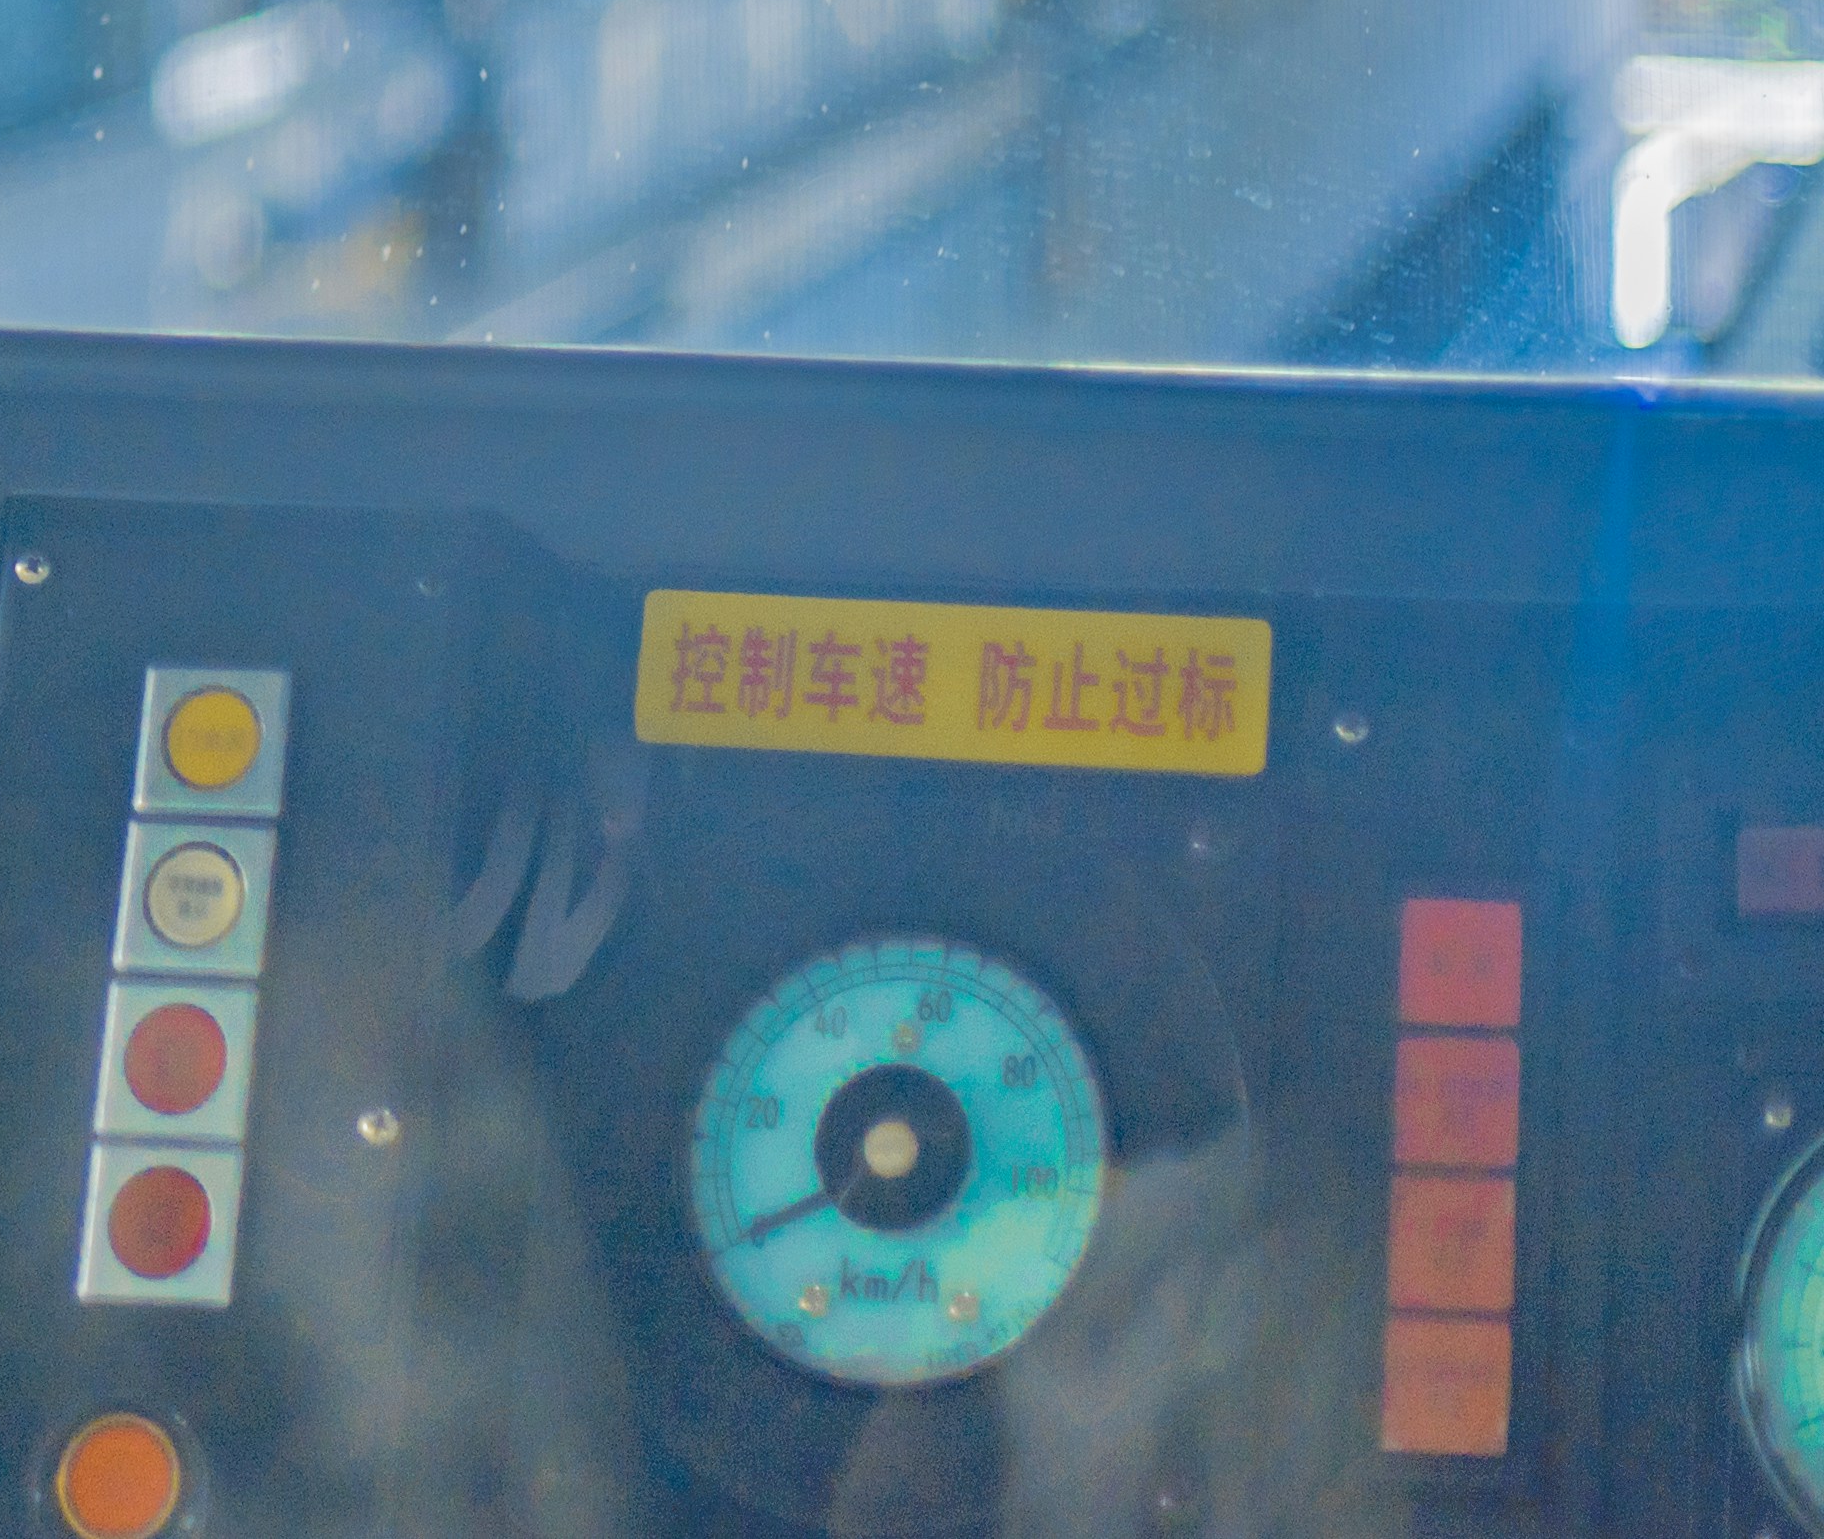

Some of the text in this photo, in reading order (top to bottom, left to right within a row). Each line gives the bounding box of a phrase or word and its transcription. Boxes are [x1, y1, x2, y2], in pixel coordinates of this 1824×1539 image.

[668, 622, 1239, 741] 控制车速 防止过标
[814, 1006, 848, 1039] 40
[917, 991, 953, 1023] 60
[1001, 1054, 1039, 1088] 80
[745, 1096, 780, 1130] 20
[838, 1257, 940, 1304] km/h
